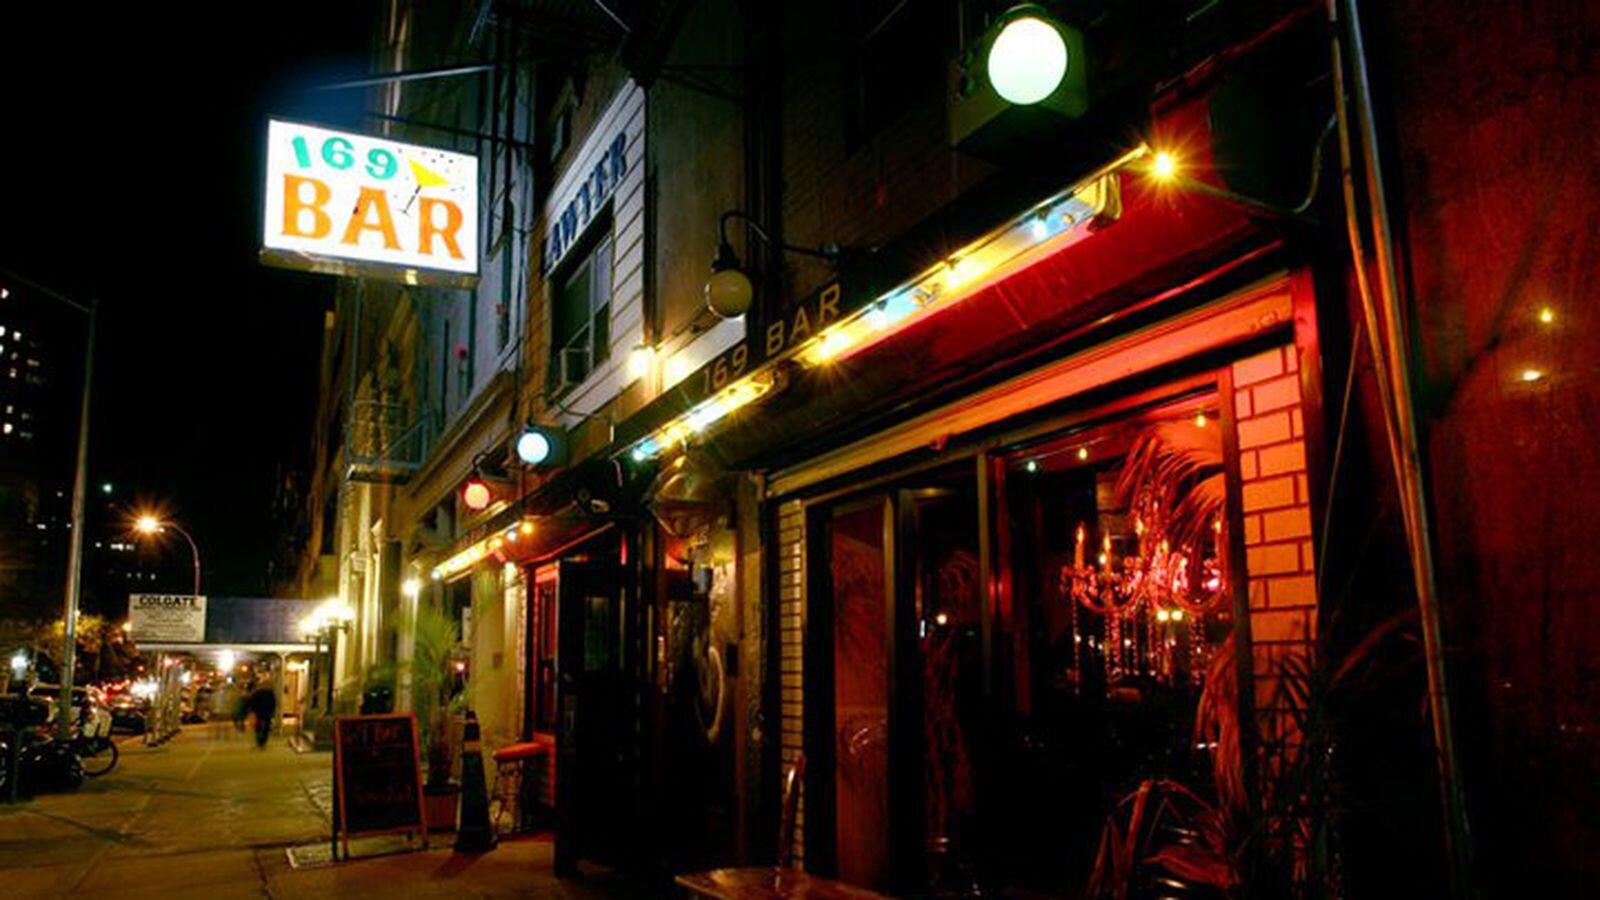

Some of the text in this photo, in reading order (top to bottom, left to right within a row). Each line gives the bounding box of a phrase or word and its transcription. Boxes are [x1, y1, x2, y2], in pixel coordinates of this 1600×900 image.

[292, 136, 398, 180] 169
[282, 173, 465, 260] BAR
[703, 283, 841, 394] 169 BAR
